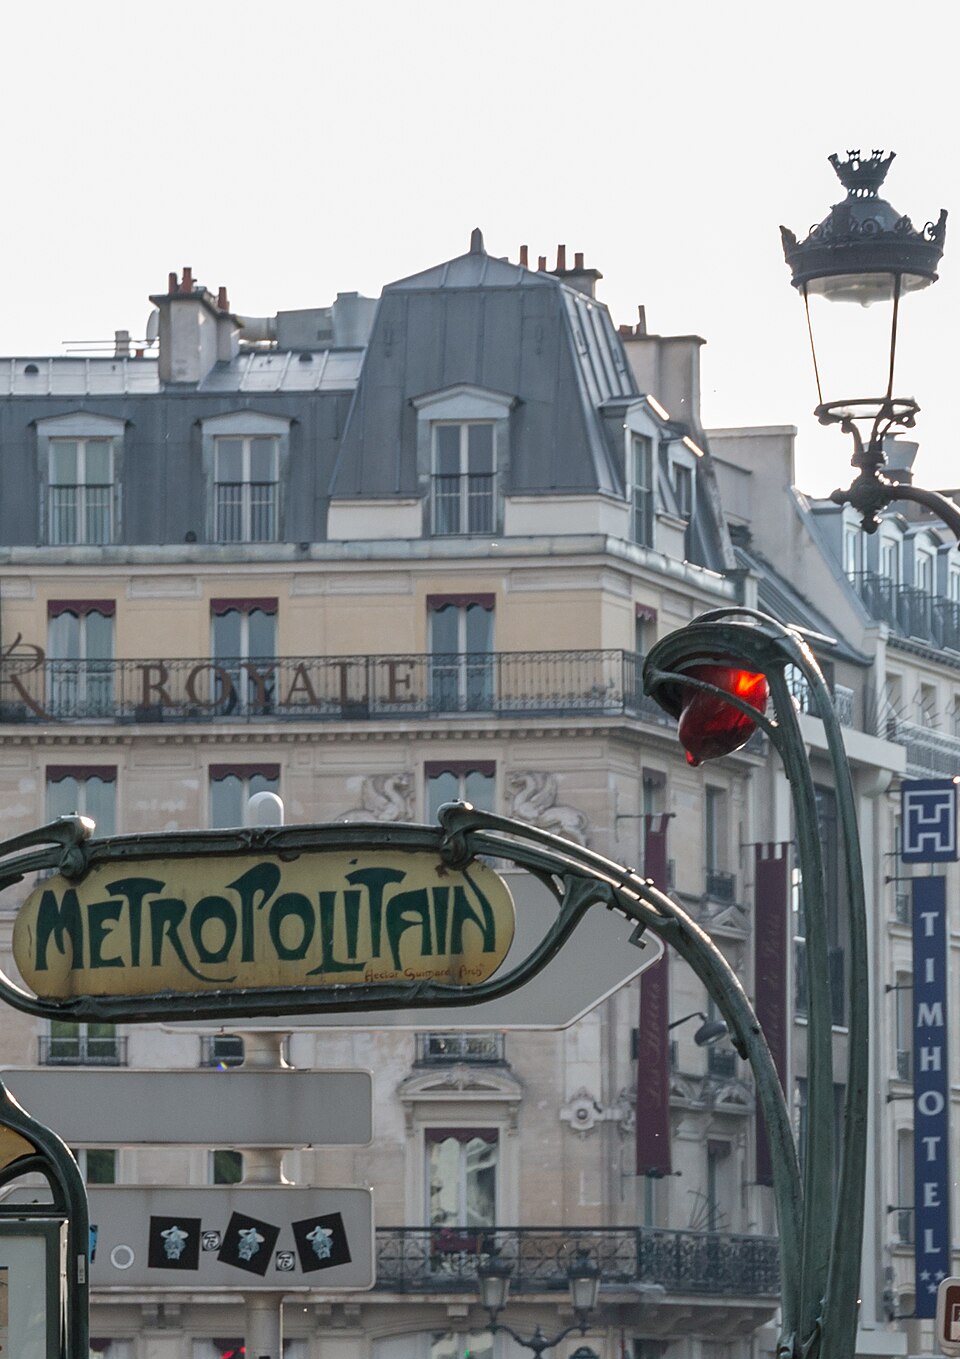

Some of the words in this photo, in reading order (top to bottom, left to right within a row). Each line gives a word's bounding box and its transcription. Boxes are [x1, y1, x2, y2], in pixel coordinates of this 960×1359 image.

[137, 660, 417, 707] ROYALE
[34, 860, 496, 983] METROPOLITAIN
[917, 911, 945, 1253] TIMHOTEL
